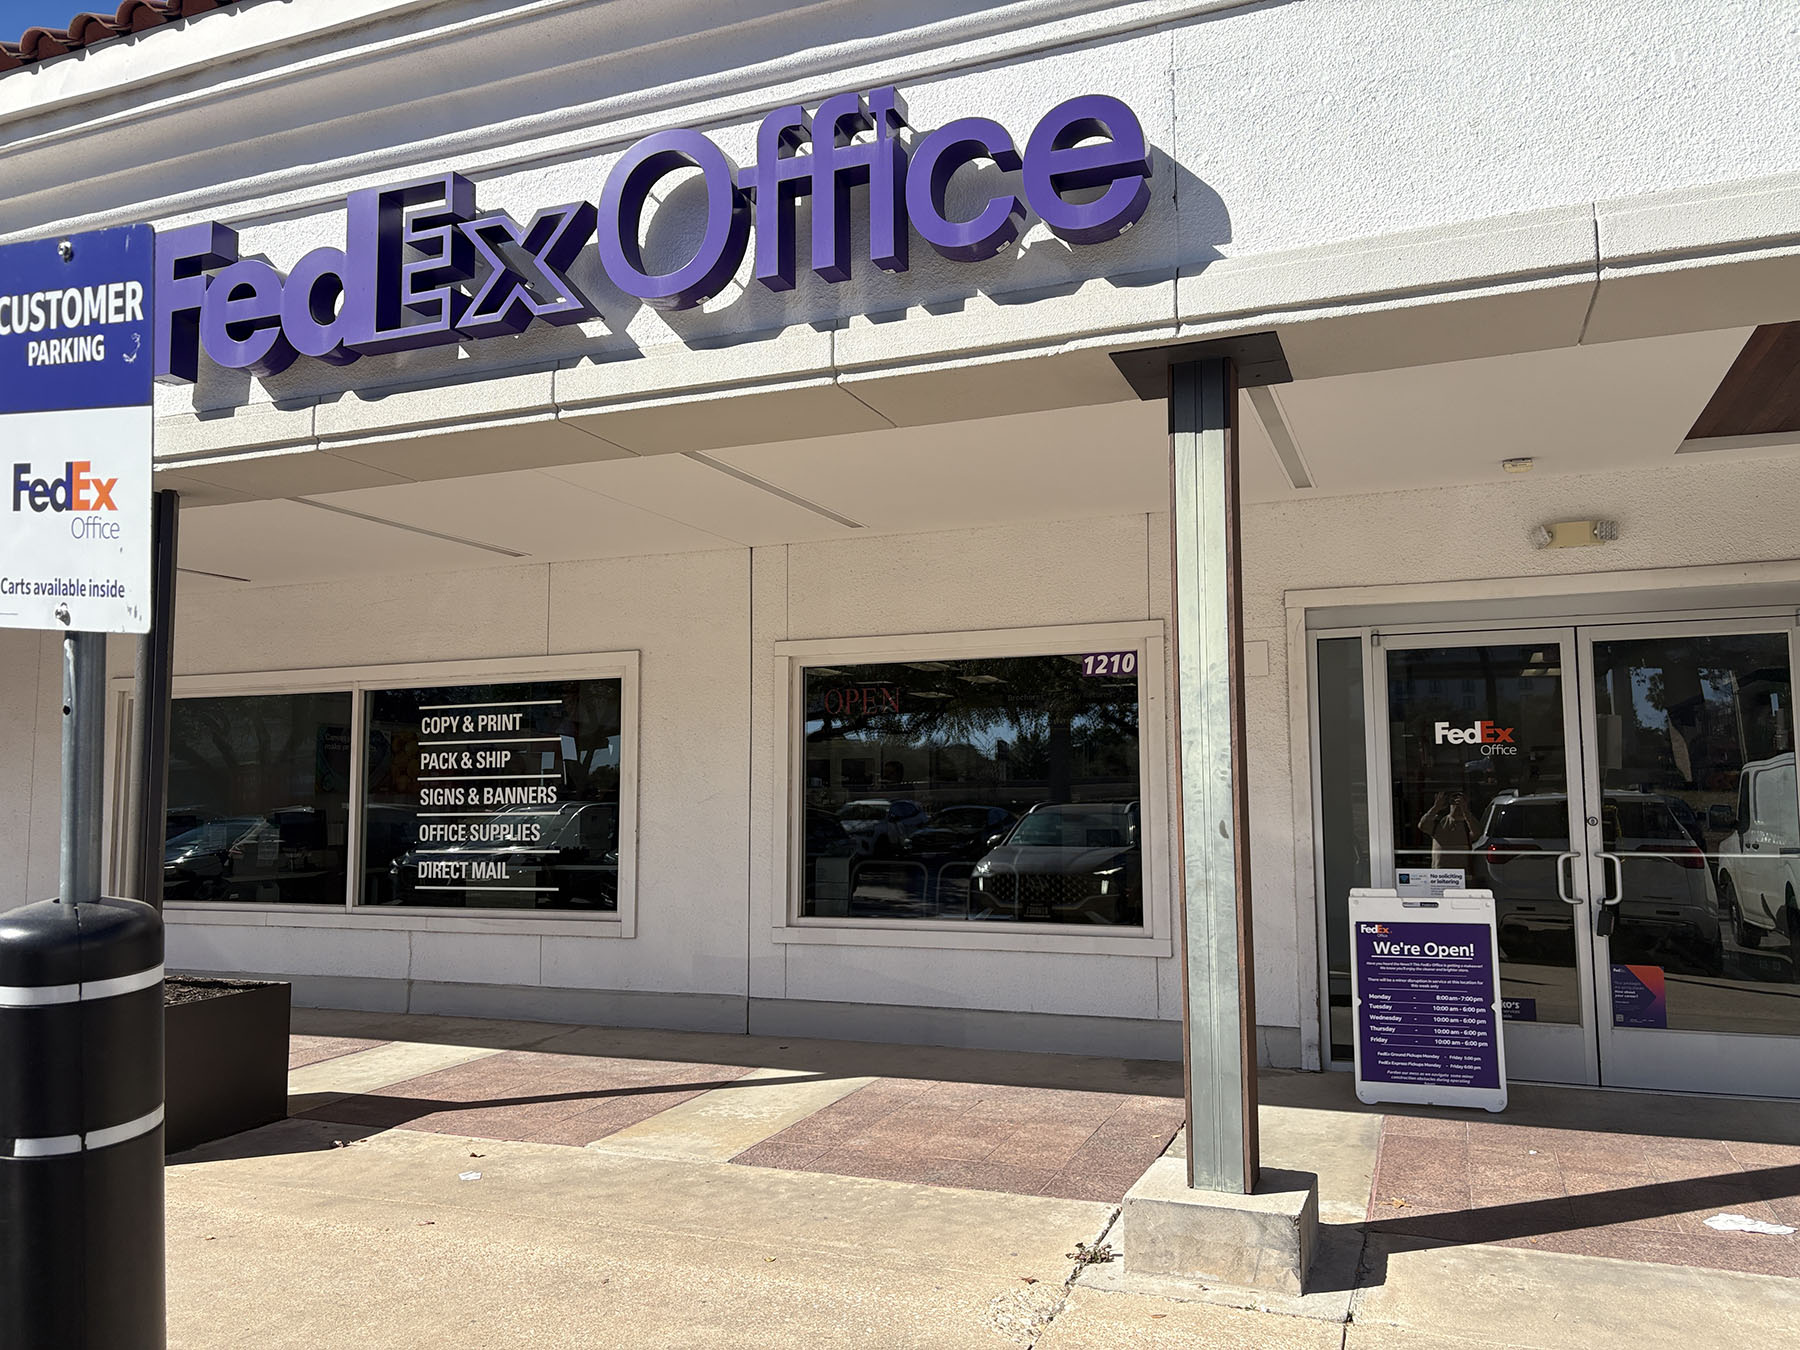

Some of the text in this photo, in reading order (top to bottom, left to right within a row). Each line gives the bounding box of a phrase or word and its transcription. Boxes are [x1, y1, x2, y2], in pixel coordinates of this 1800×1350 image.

[153, 86, 1153, 386] FedEx Office
[0, 281, 144, 335] CUSTOMER
[28, 334, 105, 367] PARKING
[13, 461, 118, 512] FedEx
[71, 516, 120, 539] Office
[0, 577, 125, 598] Carts available inside
[1084, 653, 1135, 675] 1210
[824, 687, 901, 715] OPEN
[421, 713, 523, 734] COPY & PRINT
[1434, 721, 1515, 745] FedEx
[420, 750, 511, 770] PACK & SHIP
[1480, 744, 1517, 756] Office
[420, 786, 558, 806] SIGNS & BANNERS
[419, 823, 541, 842] OFFICE SUPPLIES
[417, 862, 510, 880] DIRECT MAIL
[1360, 924, 1389, 934] FedEx
[1373, 941, 1475, 959] We're Open!
[1368, 1003, 1392, 1011] Tuesday
[1369, 993, 1392, 1001] Monday
[1369, 1014, 1402, 1022] Wednesday
[1369, 1025, 1396, 1033] Thursday
[1370, 1036, 1388, 1044] Friday
